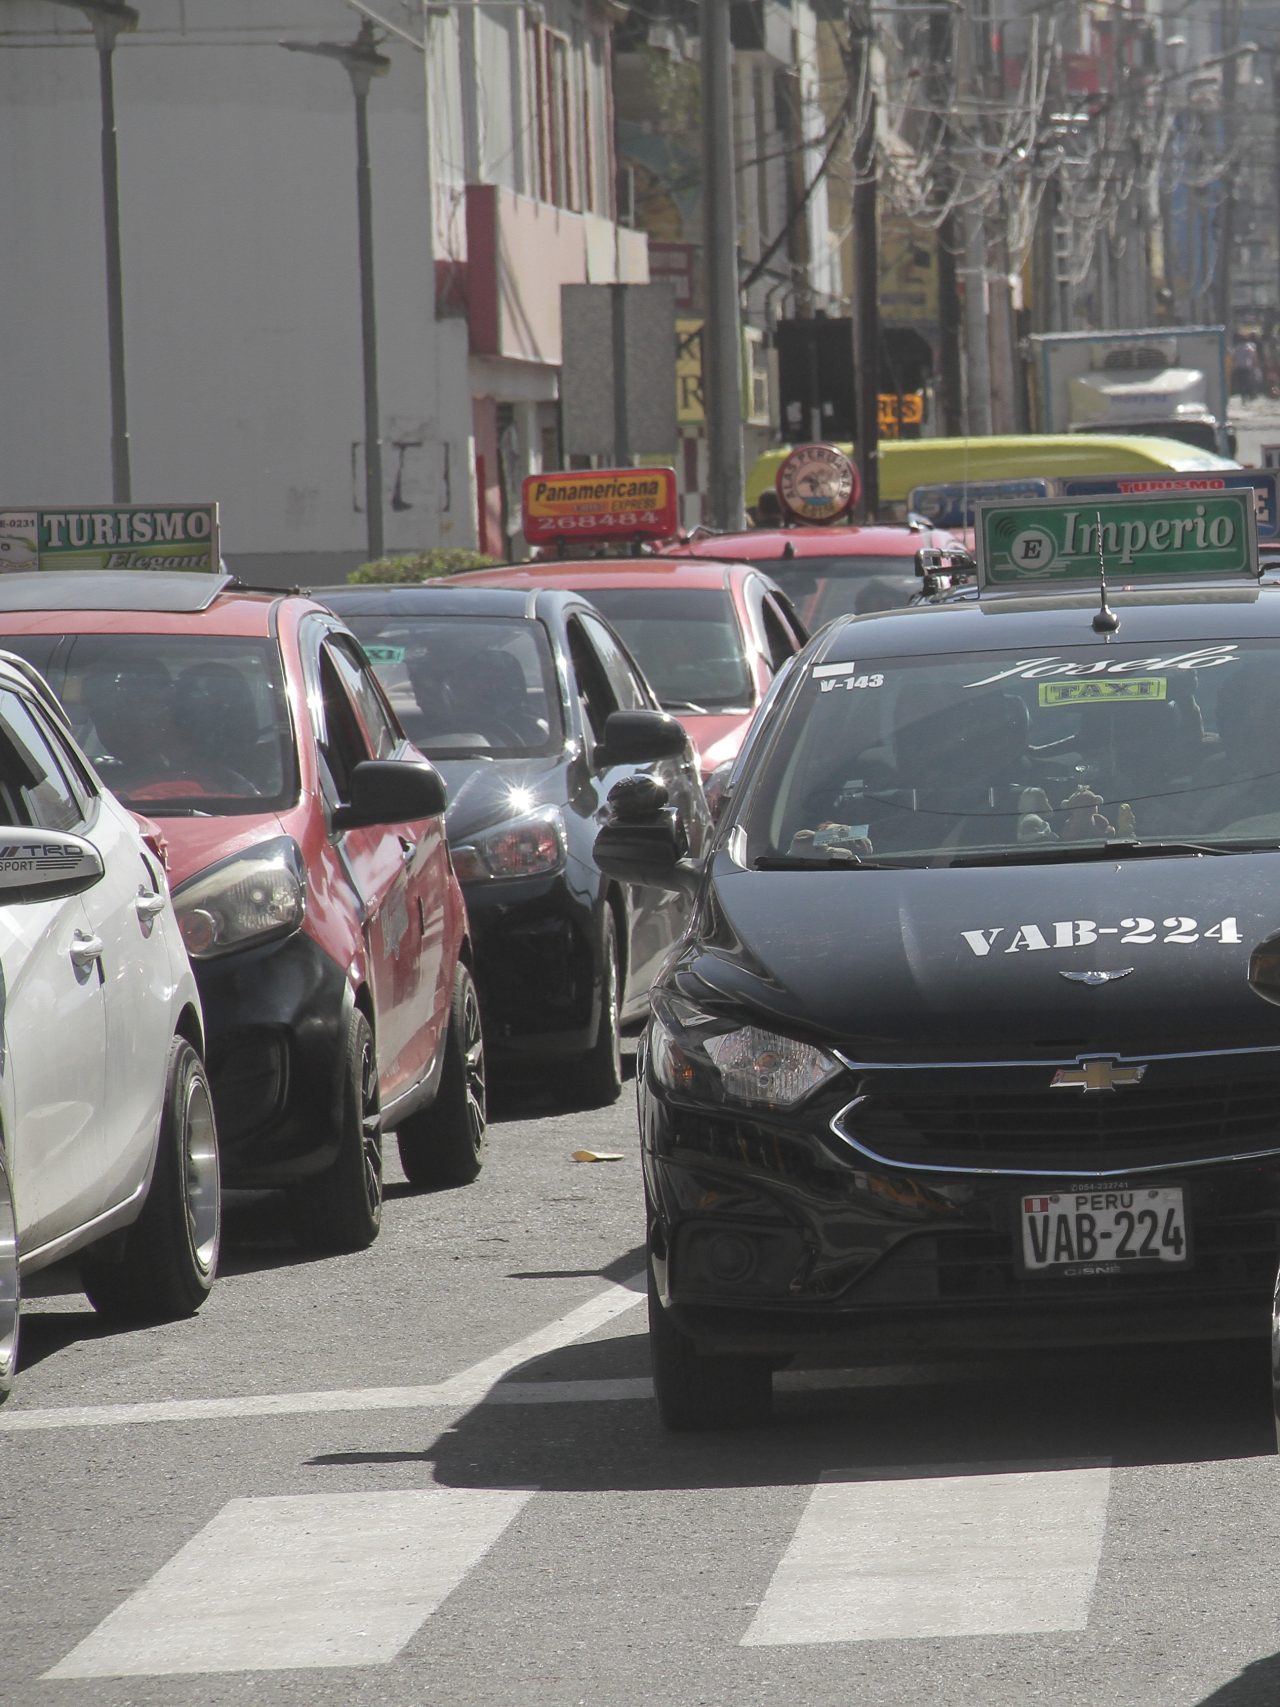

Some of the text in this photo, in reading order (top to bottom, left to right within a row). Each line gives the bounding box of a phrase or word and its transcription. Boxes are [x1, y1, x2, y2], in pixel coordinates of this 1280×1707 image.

[535, 479, 659, 502] Panamericana
[1117, 479, 1225, 496] TURISMO
[42, 511, 211, 547] TURISMO
[537, 512, 658, 530] 268484
[1060, 504, 1235, 565] Imperio
[1021, 539, 1042, 560] E
[103, 552, 209, 571] Elegant
[962, 645, 1240, 689] Joselo
[820, 674, 884, 692] V-143
[1050, 681, 1155, 701] TAXI
[22, 844, 83, 857] TRD
[960, 917, 1244, 956] VAB-224
[1075, 1193, 1134, 1212] PERU
[1028, 1207, 1184, 1263] VAB-224
